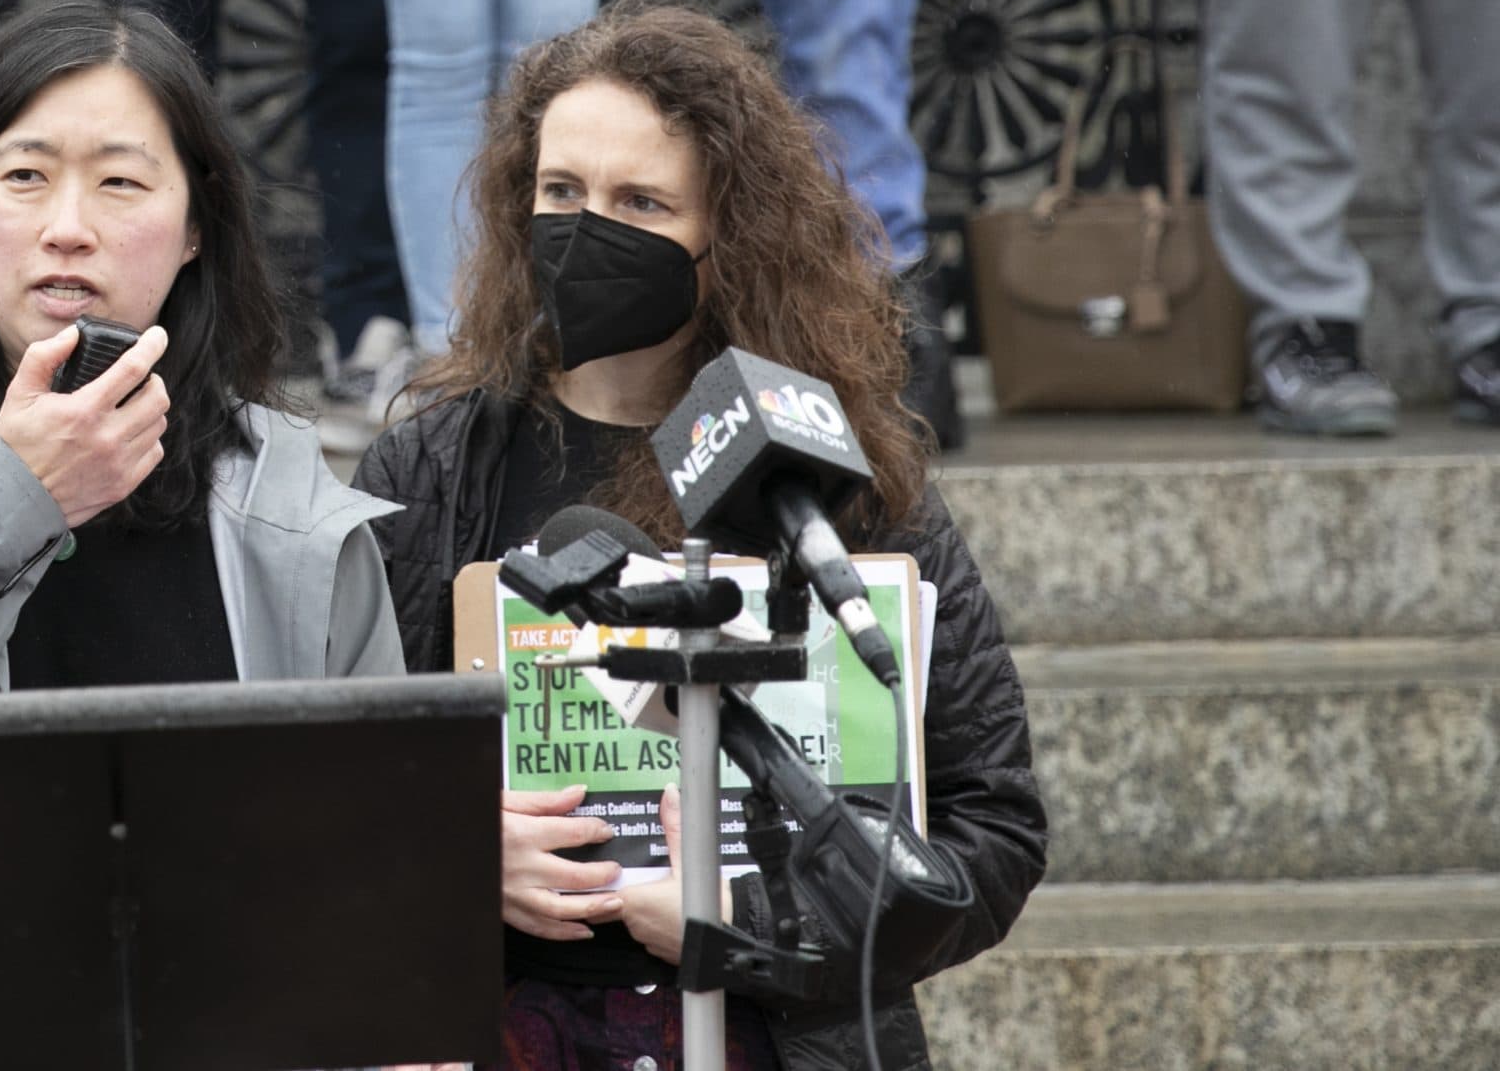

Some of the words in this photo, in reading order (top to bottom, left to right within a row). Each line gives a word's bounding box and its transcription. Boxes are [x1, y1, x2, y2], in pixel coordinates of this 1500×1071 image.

[670, 396, 750, 497] NECN
[772, 414, 849, 452] BOSTON
[510, 631, 547, 647] TAKE
[551, 629, 579, 646] ACT
[561, 699, 636, 732] EME
[516, 741, 628, 774] RENTAL
[607, 801, 645, 816] Coalition
[646, 801, 660, 814] for
[621, 822, 649, 836] Health
